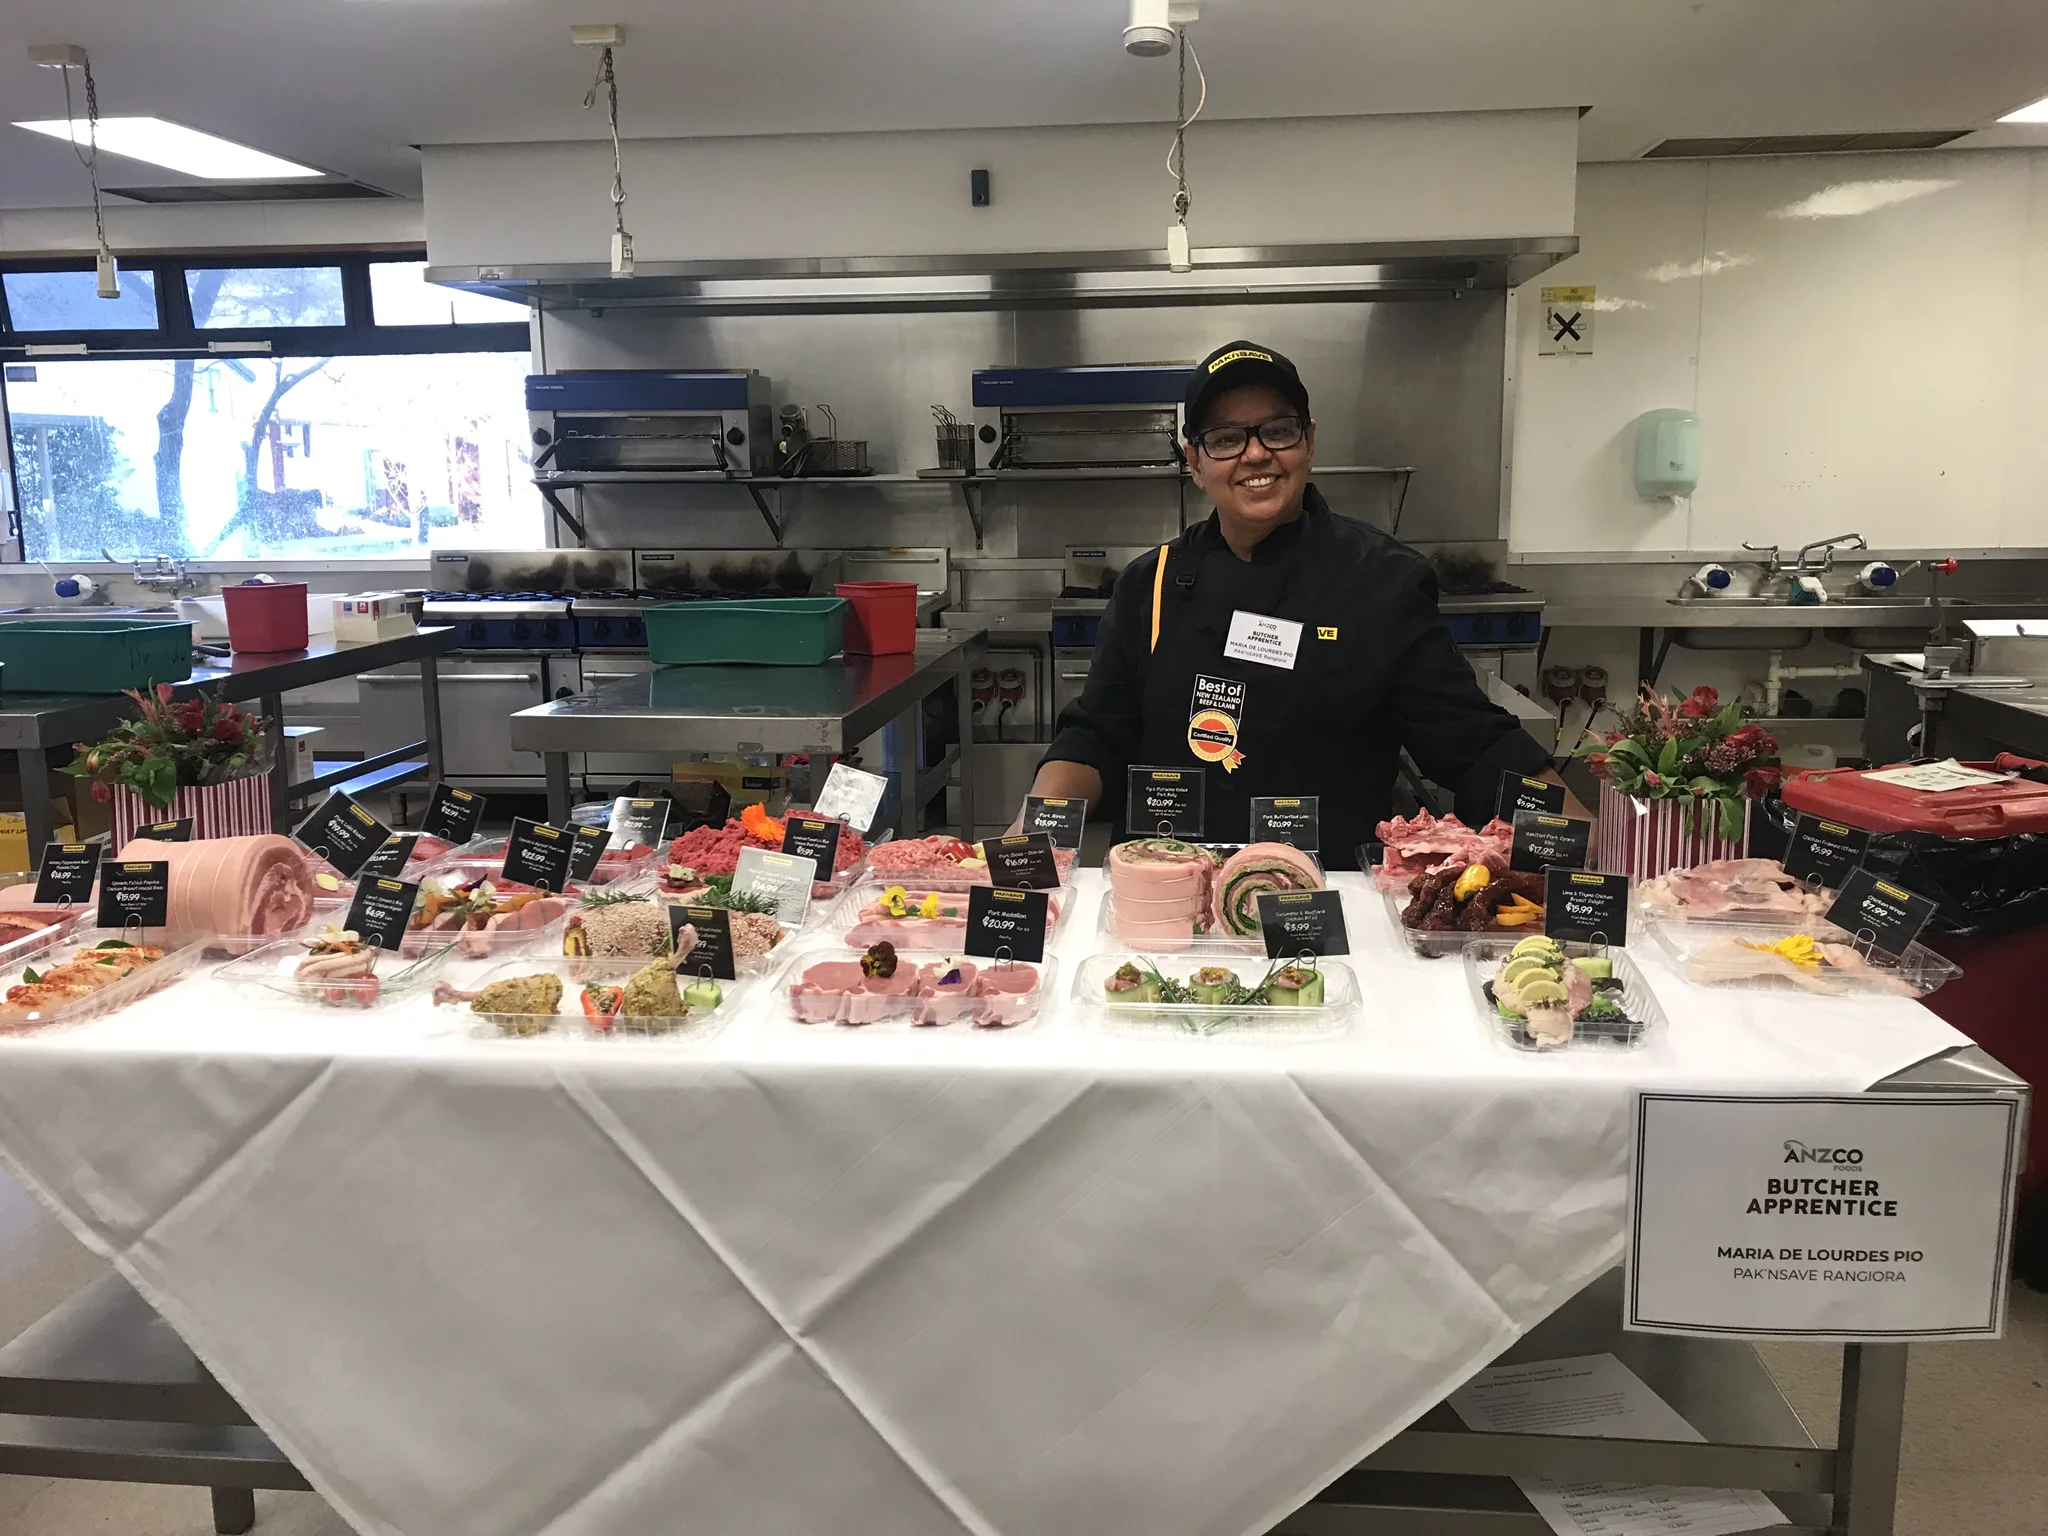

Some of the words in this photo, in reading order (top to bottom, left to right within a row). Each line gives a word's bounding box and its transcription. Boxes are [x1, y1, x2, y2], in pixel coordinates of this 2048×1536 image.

[1247, 635, 1282, 646] APPRENTICE
[1253, 631, 1279, 640] BUTCHER
[1230, 641, 1248, 649] MARIA
[1257, 646, 1282, 655] LOURDES
[1263, 655, 1287, 663] Rangiora
[1199, 679, 1226, 693] Best
[1227, 685, 1242, 696] of
[1196, 691, 1211, 699] NEW
[1212, 693, 1241, 704] ZEALAND
[1218, 702, 1236, 710] LAMB
[1193, 732, 1214, 740] Certified
[1214, 735, 1233, 743] Quality
[1147, 797, 1173, 806] $20.99
[1268, 820, 1292, 828] $20.99
[1810, 843, 1832, 857] $5.99
[1565, 902, 1593, 914] $15.99
[1868, 895, 1889, 908] Chicken
[1862, 900, 1888, 917] $7.99
[982, 916, 1015, 930] $20.99
[1284, 922, 1310, 931] $3.99
[1784, 1146, 1863, 1164] ANZCO
[1768, 1179, 1879, 1196] BUTCHER
[1746, 1198, 1898, 1216] APPRENTICE
[1717, 1247, 1775, 1260] MARIA
[1779, 1249, 1803, 1260] DE
[1807, 1249, 1889, 1262] LOURDES
[1894, 1250, 1924, 1262] PIO
[1733, 1268, 1818, 1281] PAK'NSAVE
[1823, 1270, 1906, 1282] RANGIORA
